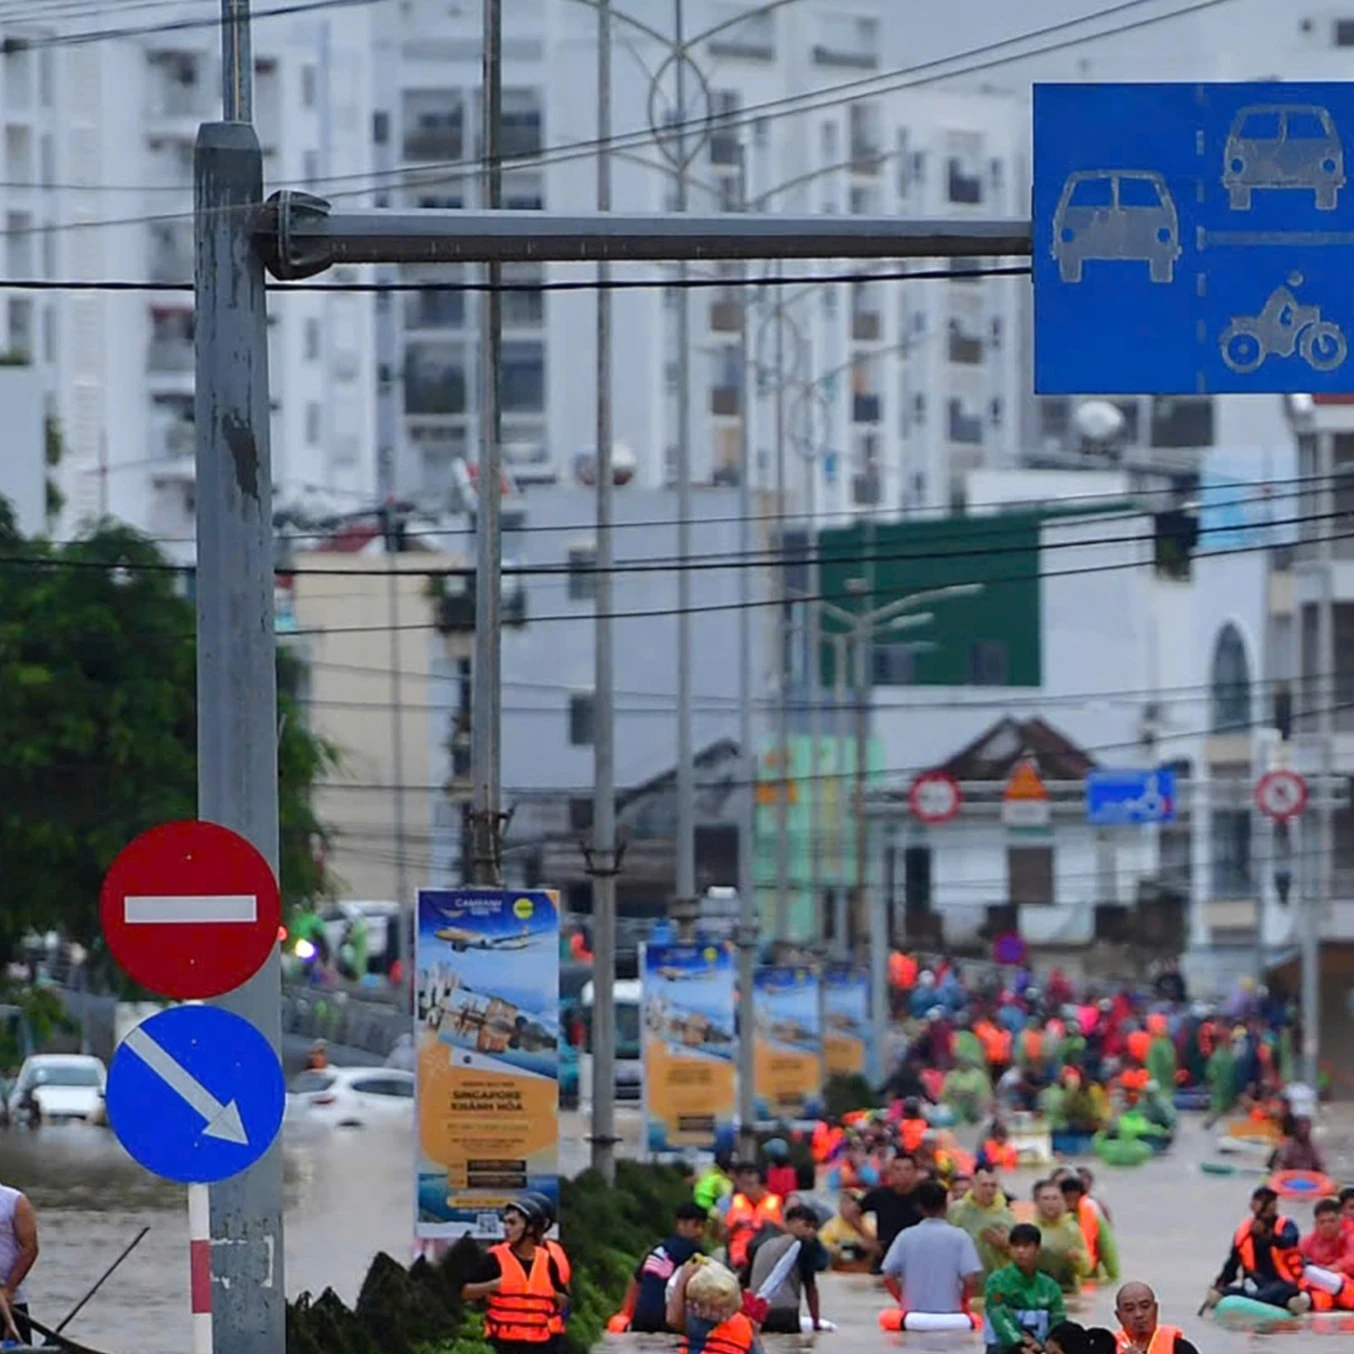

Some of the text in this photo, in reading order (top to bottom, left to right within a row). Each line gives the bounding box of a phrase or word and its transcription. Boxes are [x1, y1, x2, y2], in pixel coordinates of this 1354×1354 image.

[453, 1091, 521, 1100] SINGAPORE
[451, 1101, 523, 1111] KHÁNH HÒA
